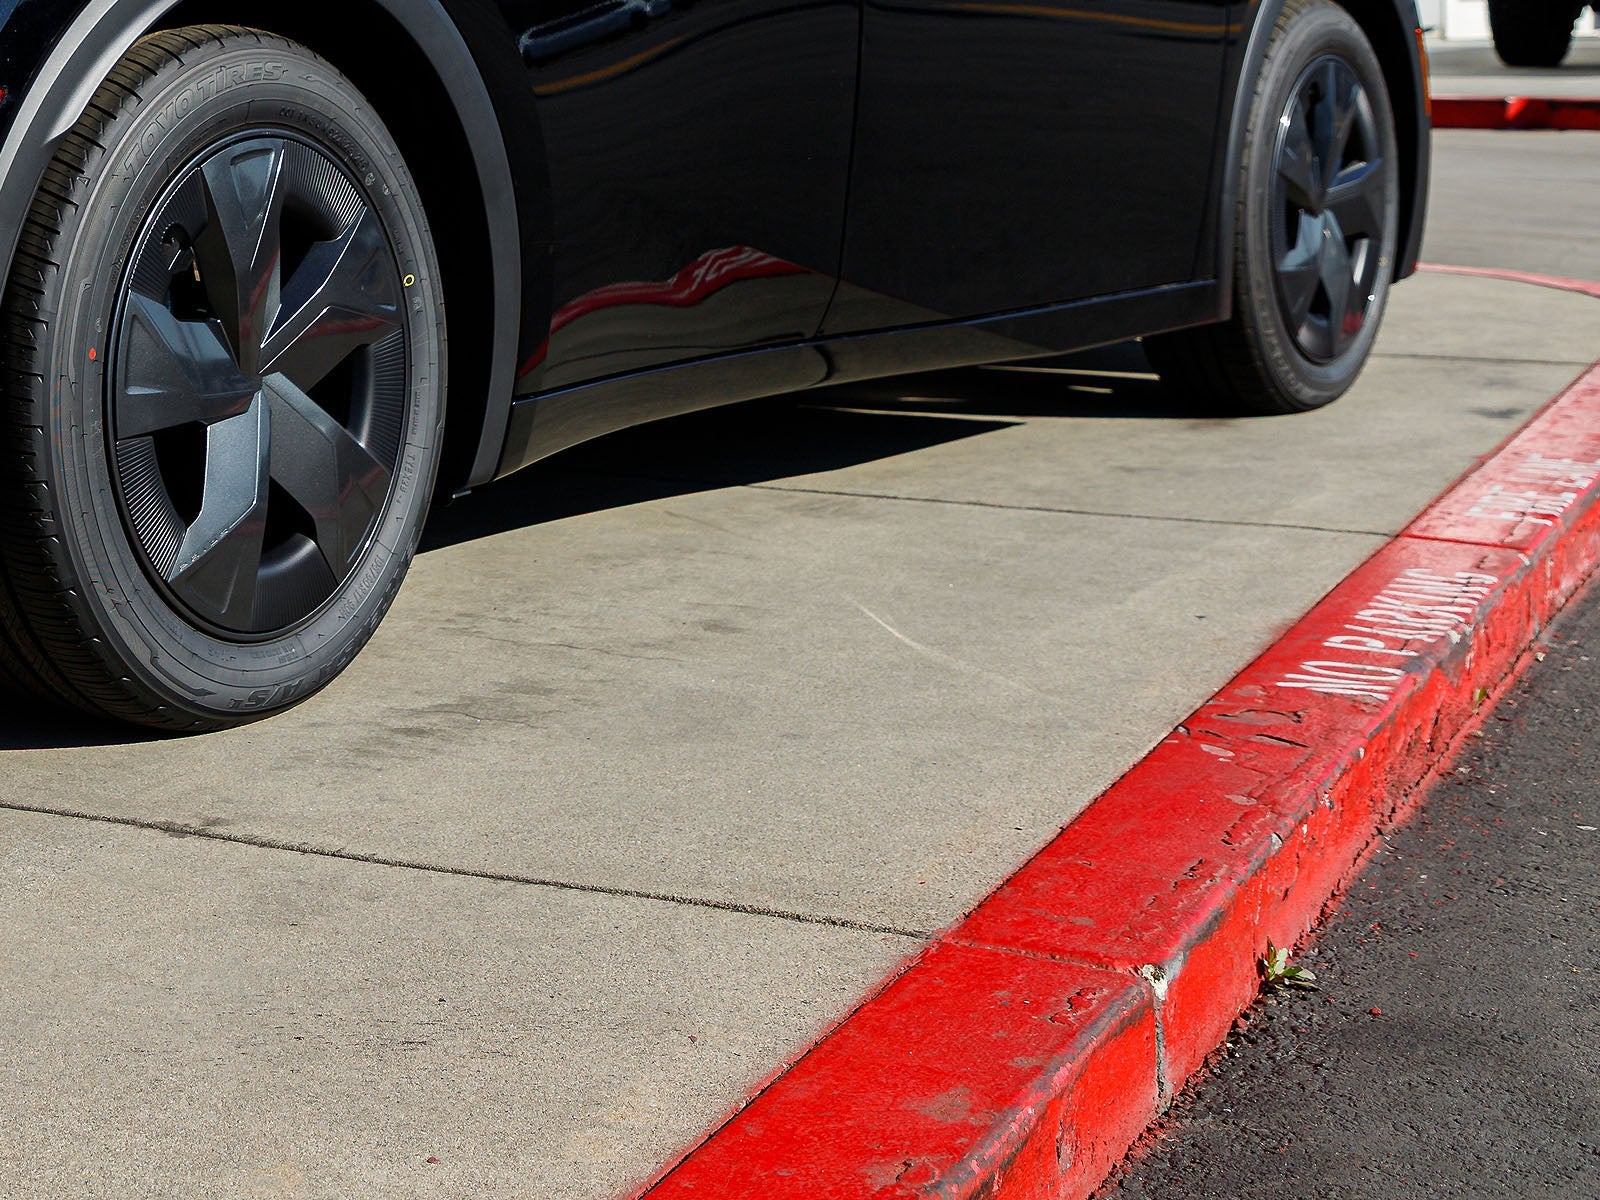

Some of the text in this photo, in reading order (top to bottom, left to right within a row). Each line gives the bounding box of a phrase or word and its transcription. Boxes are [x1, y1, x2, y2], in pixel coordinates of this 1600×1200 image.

[123, 60, 285, 179] TOYO TIRES
[1275, 568, 1499, 700] NO PARKING
